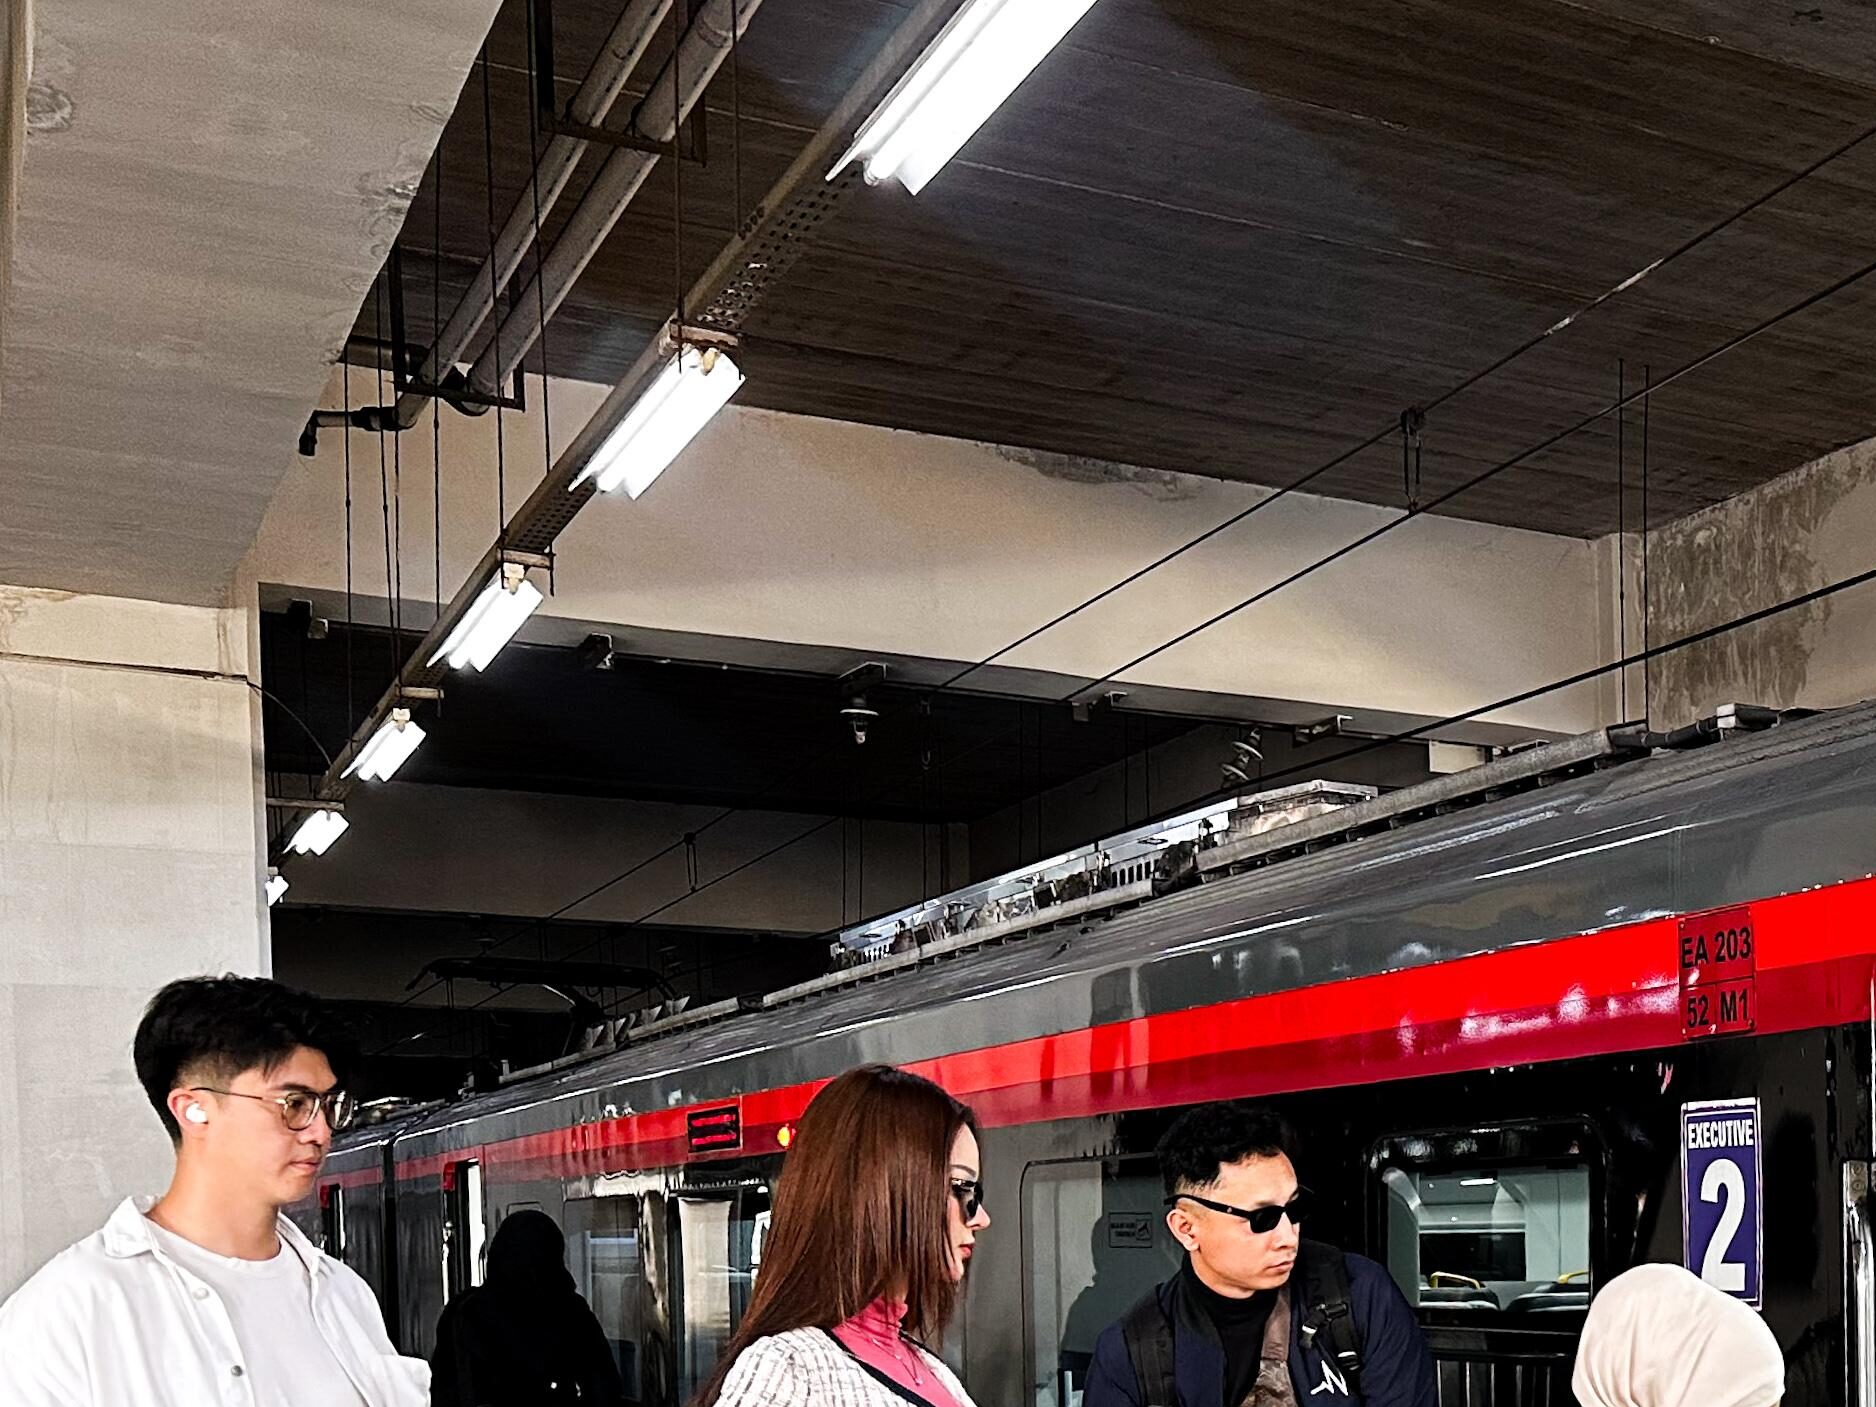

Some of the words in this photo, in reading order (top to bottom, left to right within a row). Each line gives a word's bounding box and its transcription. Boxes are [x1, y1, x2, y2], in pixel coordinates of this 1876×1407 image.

[1681, 935, 1709, 969] EA
[1715, 927, 1752, 963] 203
[1687, 994, 1710, 1029] 52
[1720, 988, 1748, 1023] M1
[1687, 1118, 1755, 1150] EXECUTIVE
[1700, 1158, 1746, 1292] 2
